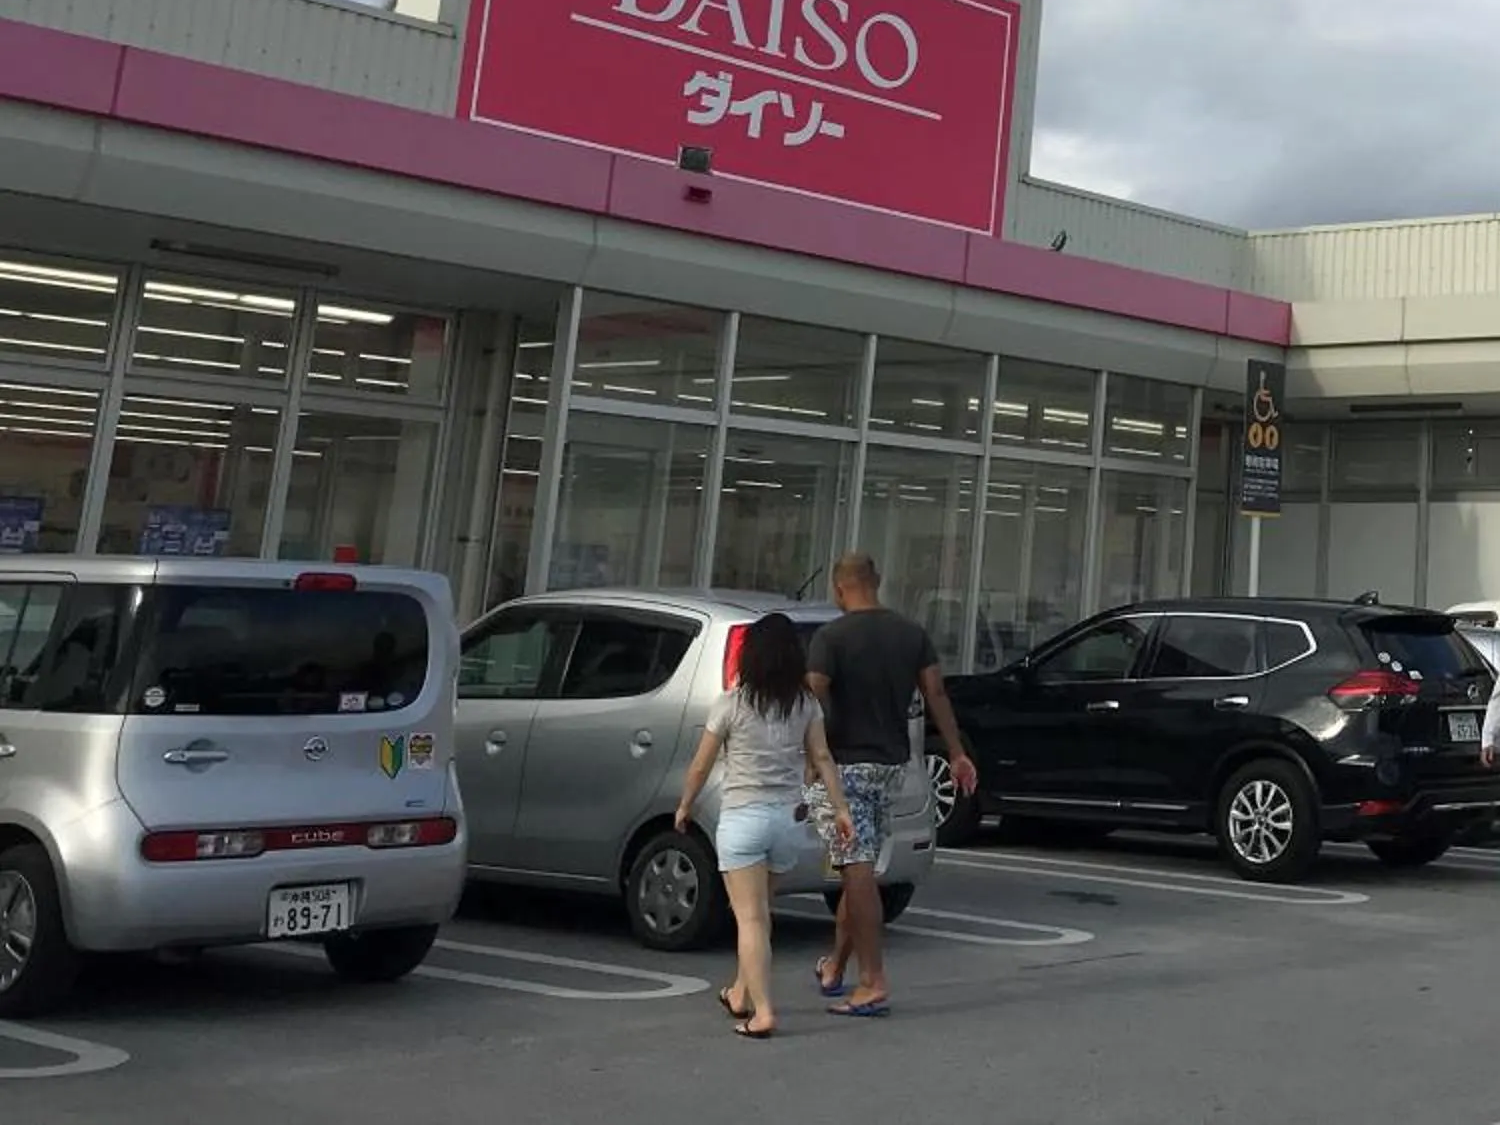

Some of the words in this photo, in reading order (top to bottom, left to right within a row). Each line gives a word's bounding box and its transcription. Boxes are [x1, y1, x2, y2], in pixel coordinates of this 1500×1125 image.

[682, 70, 846, 147] ダイソー
[291, 829, 345, 844] cube
[286, 902, 342, 932] 89-71
